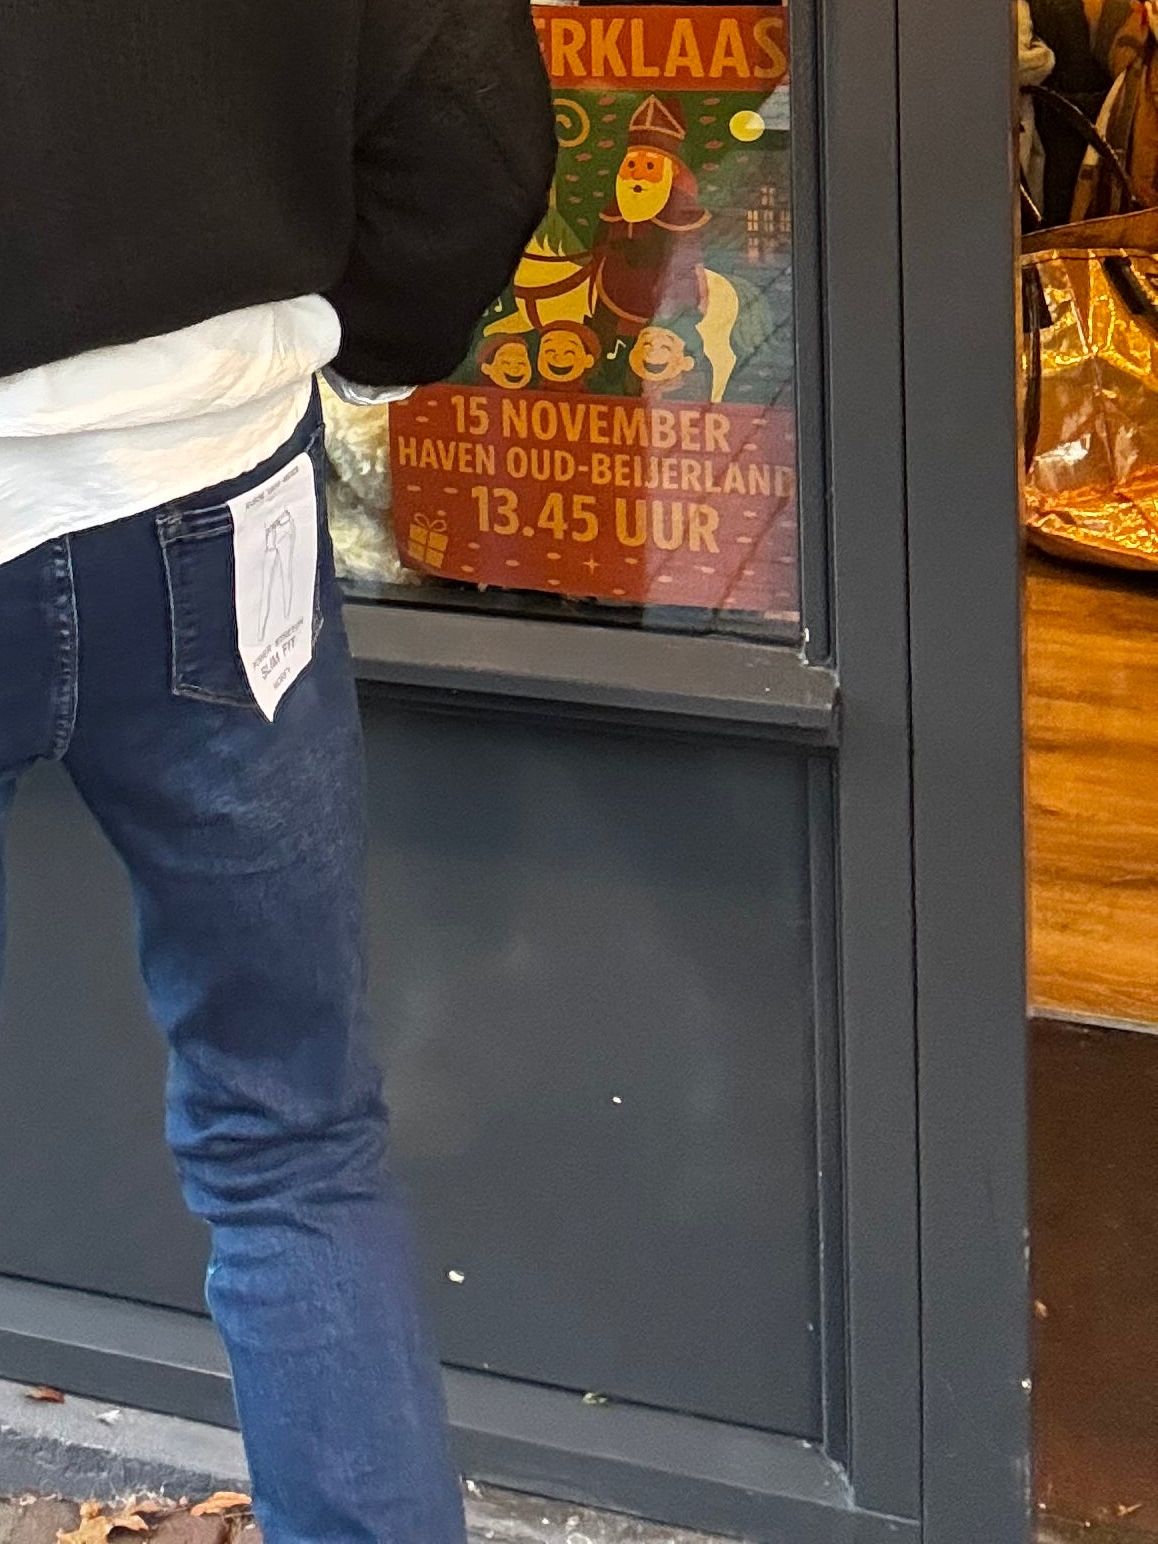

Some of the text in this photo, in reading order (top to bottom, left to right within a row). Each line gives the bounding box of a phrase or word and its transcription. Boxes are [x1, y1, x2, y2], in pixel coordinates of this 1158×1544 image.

[451, 395, 731, 453] 15 NOVEMBER
[398, 437, 496, 476] HAVEN
[471, 486, 720, 554] 13.45 UUR
[282, 635, 296, 657] FIT
